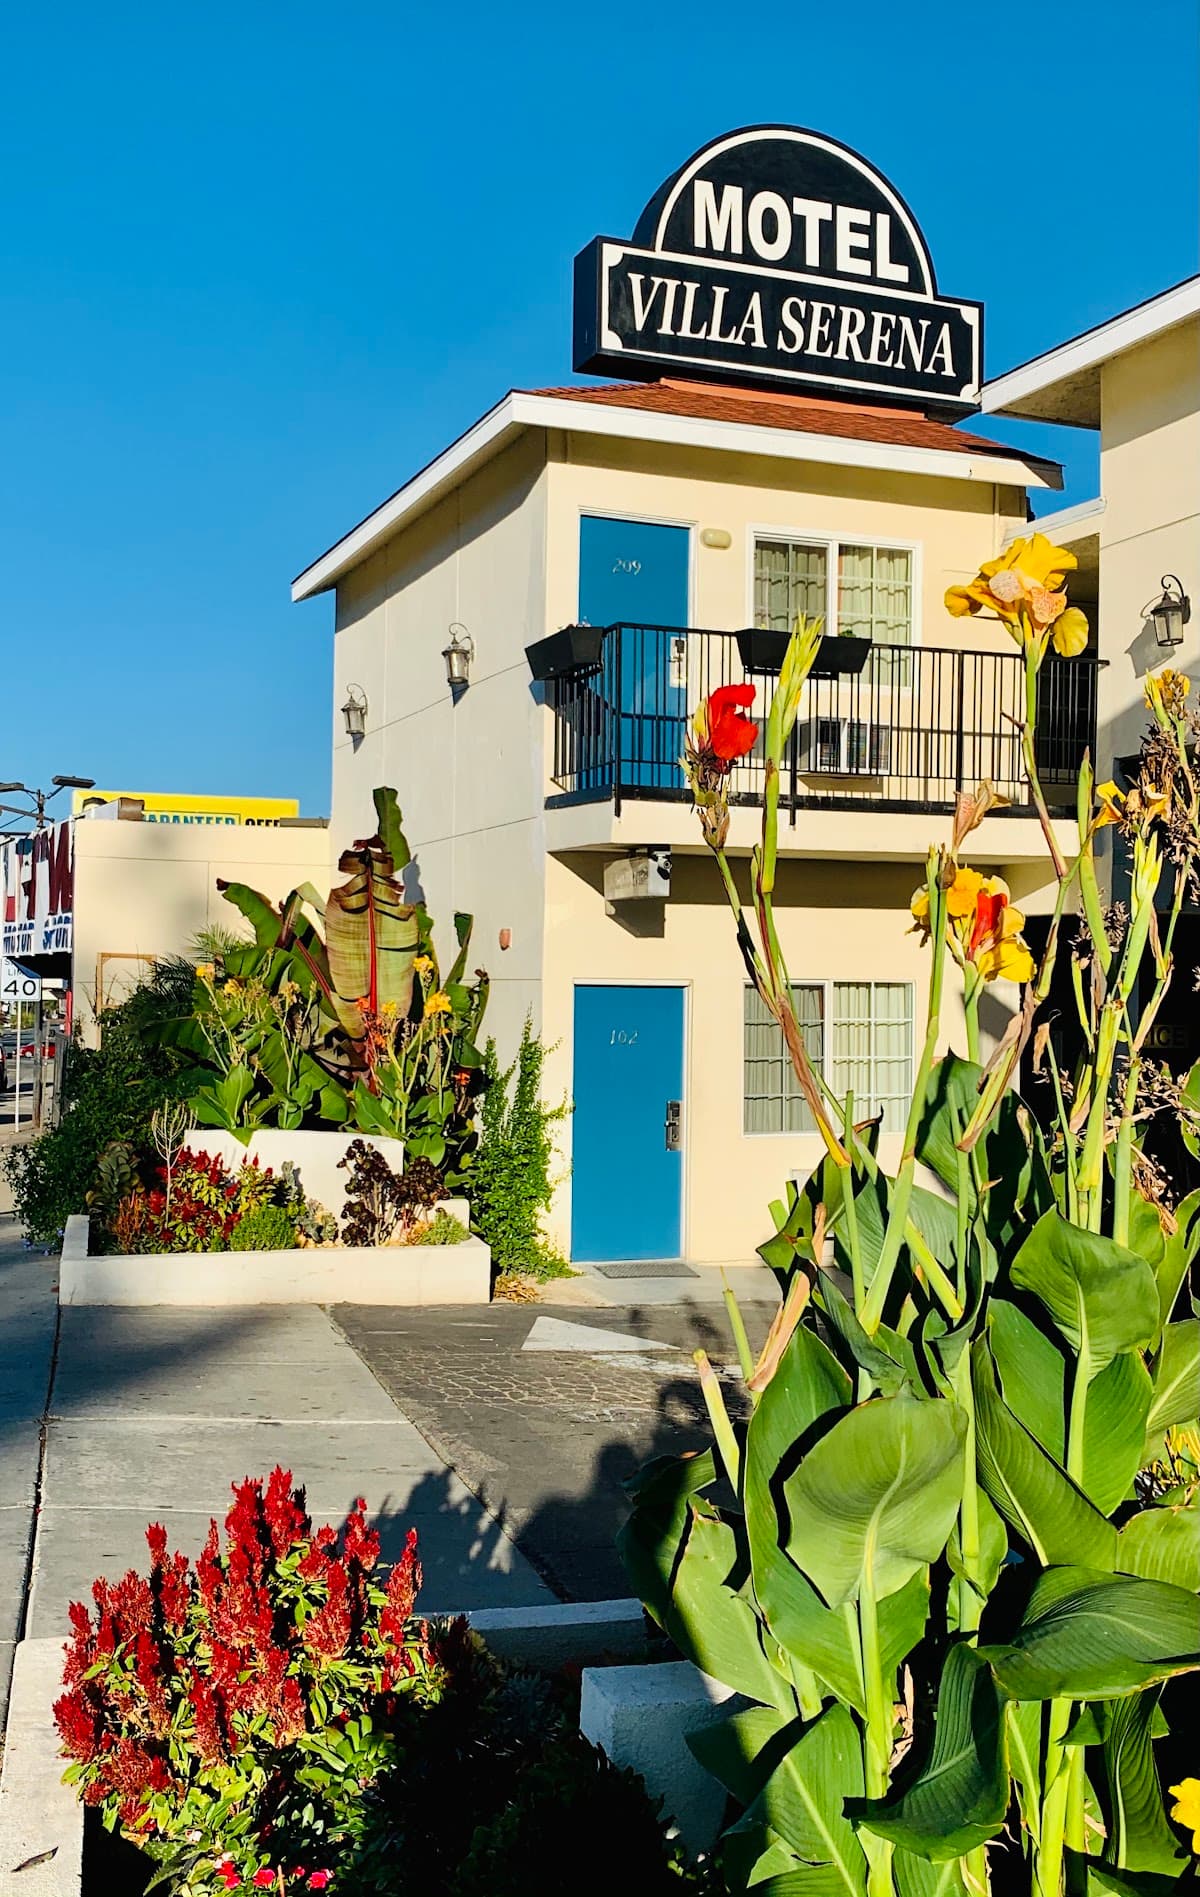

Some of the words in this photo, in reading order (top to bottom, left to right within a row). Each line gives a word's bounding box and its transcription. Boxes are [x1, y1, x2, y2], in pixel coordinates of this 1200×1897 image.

[692, 179, 910, 284] MOTEL
[626, 272, 768, 349] VILLA
[777, 296, 957, 378] SERENA
[612, 558, 642, 576] 209
[4, 980, 36, 996] 40
[610, 1029, 639, 1045] 102
[1148, 1025, 1185, 1046] ICE
